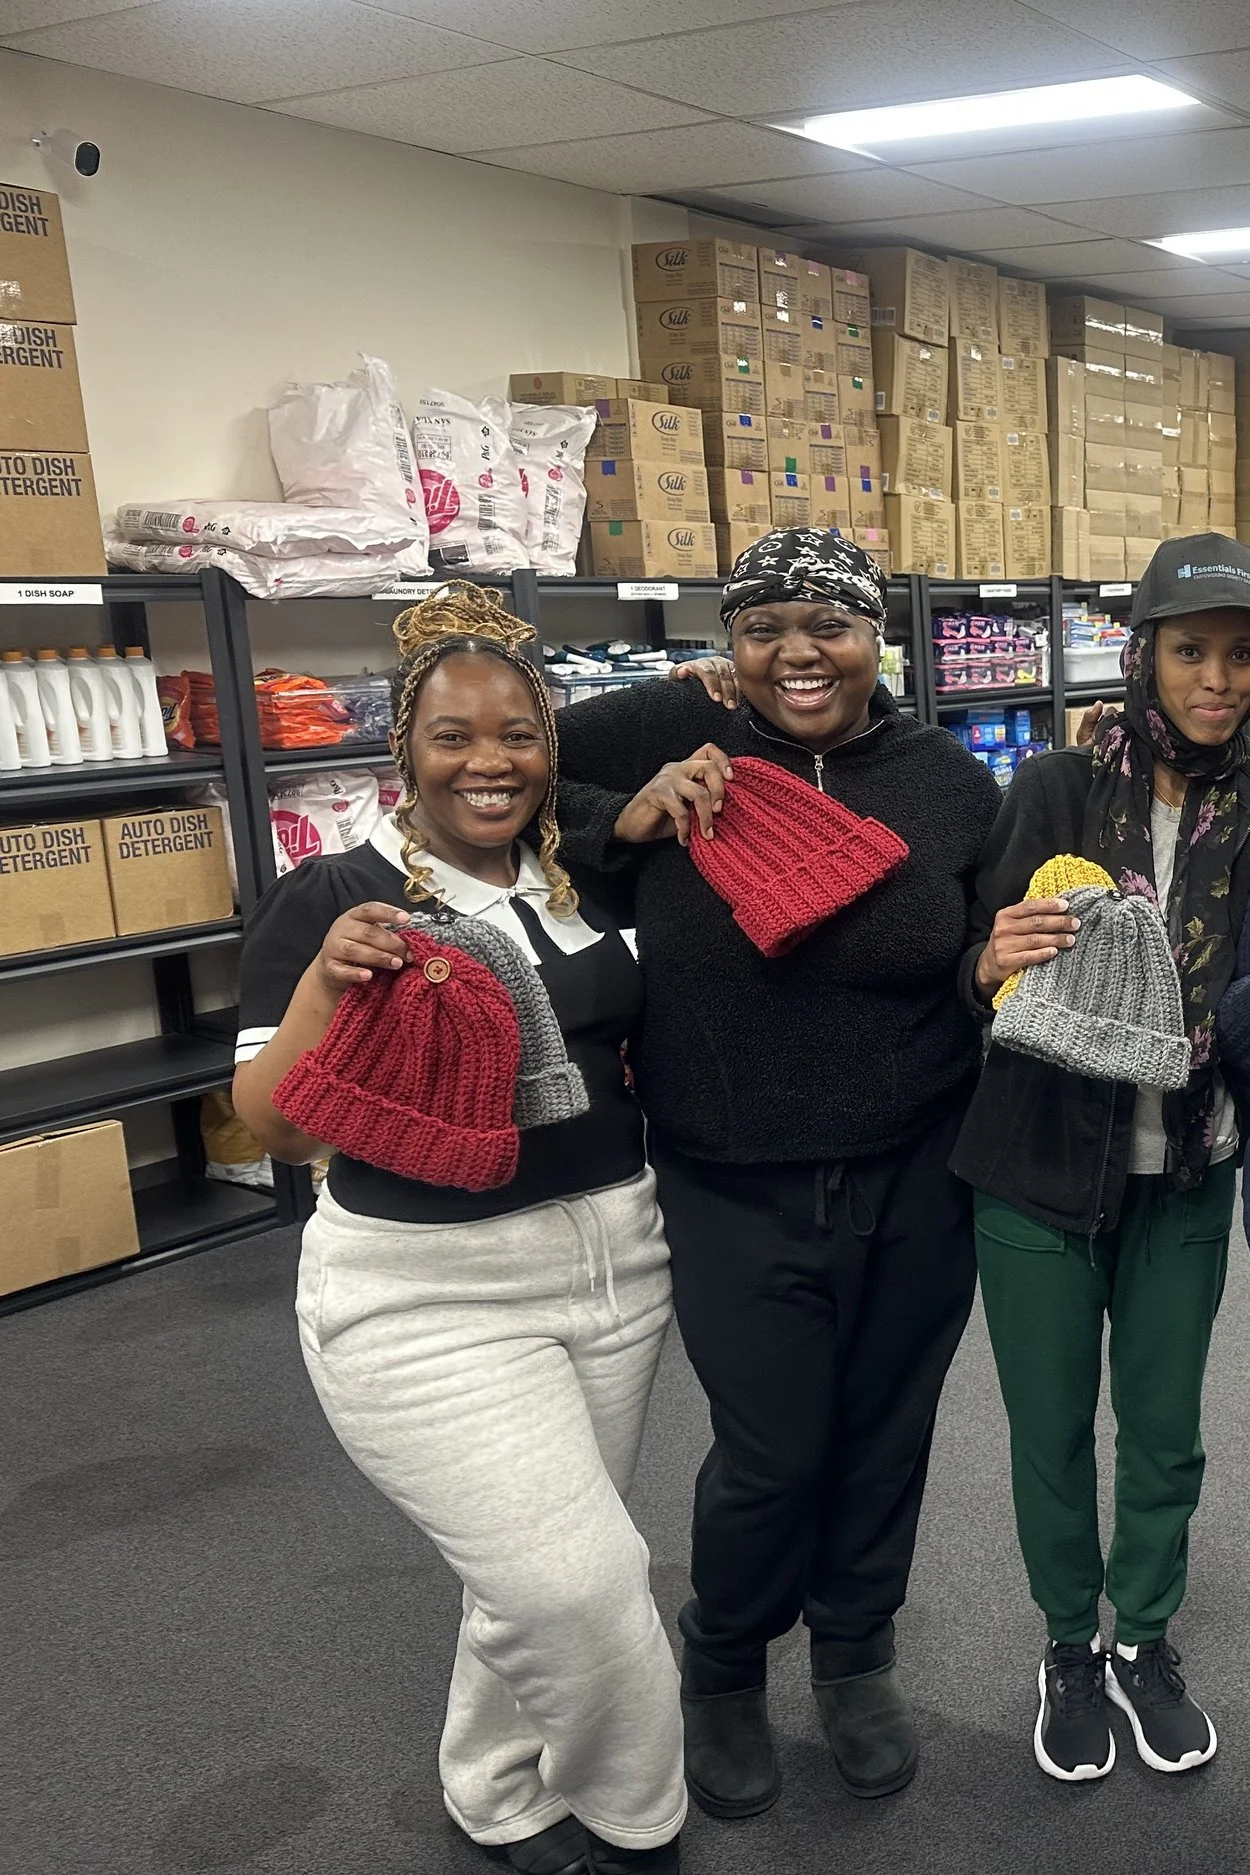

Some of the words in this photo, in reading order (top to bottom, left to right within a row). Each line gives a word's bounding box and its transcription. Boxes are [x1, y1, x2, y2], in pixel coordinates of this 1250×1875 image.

[0, 212, 49, 237] GENT
[665, 251, 688, 266] Silk
[668, 311, 691, 326] Silk
[13, 326, 57, 348] DISH
[670, 366, 692, 381] Silk
[659, 414, 681, 431] Silk
[0, 456, 26, 476] TO
[32, 457, 76, 477] DISH
[0, 477, 82, 497] TERGENT
[665, 474, 687, 491] Silk
[674, 531, 696, 547] Silk
[1191, 564, 1236, 575] Essentials
[18, 590, 22, 598] 1
[25, 590, 47, 598] DISH
[49, 590, 74, 598] SOAP
[120, 818, 165, 841] AUTO
[170, 814, 209, 831] DISH
[42, 827, 86, 849] DISH
[118, 831, 214, 860] DETERGENT
